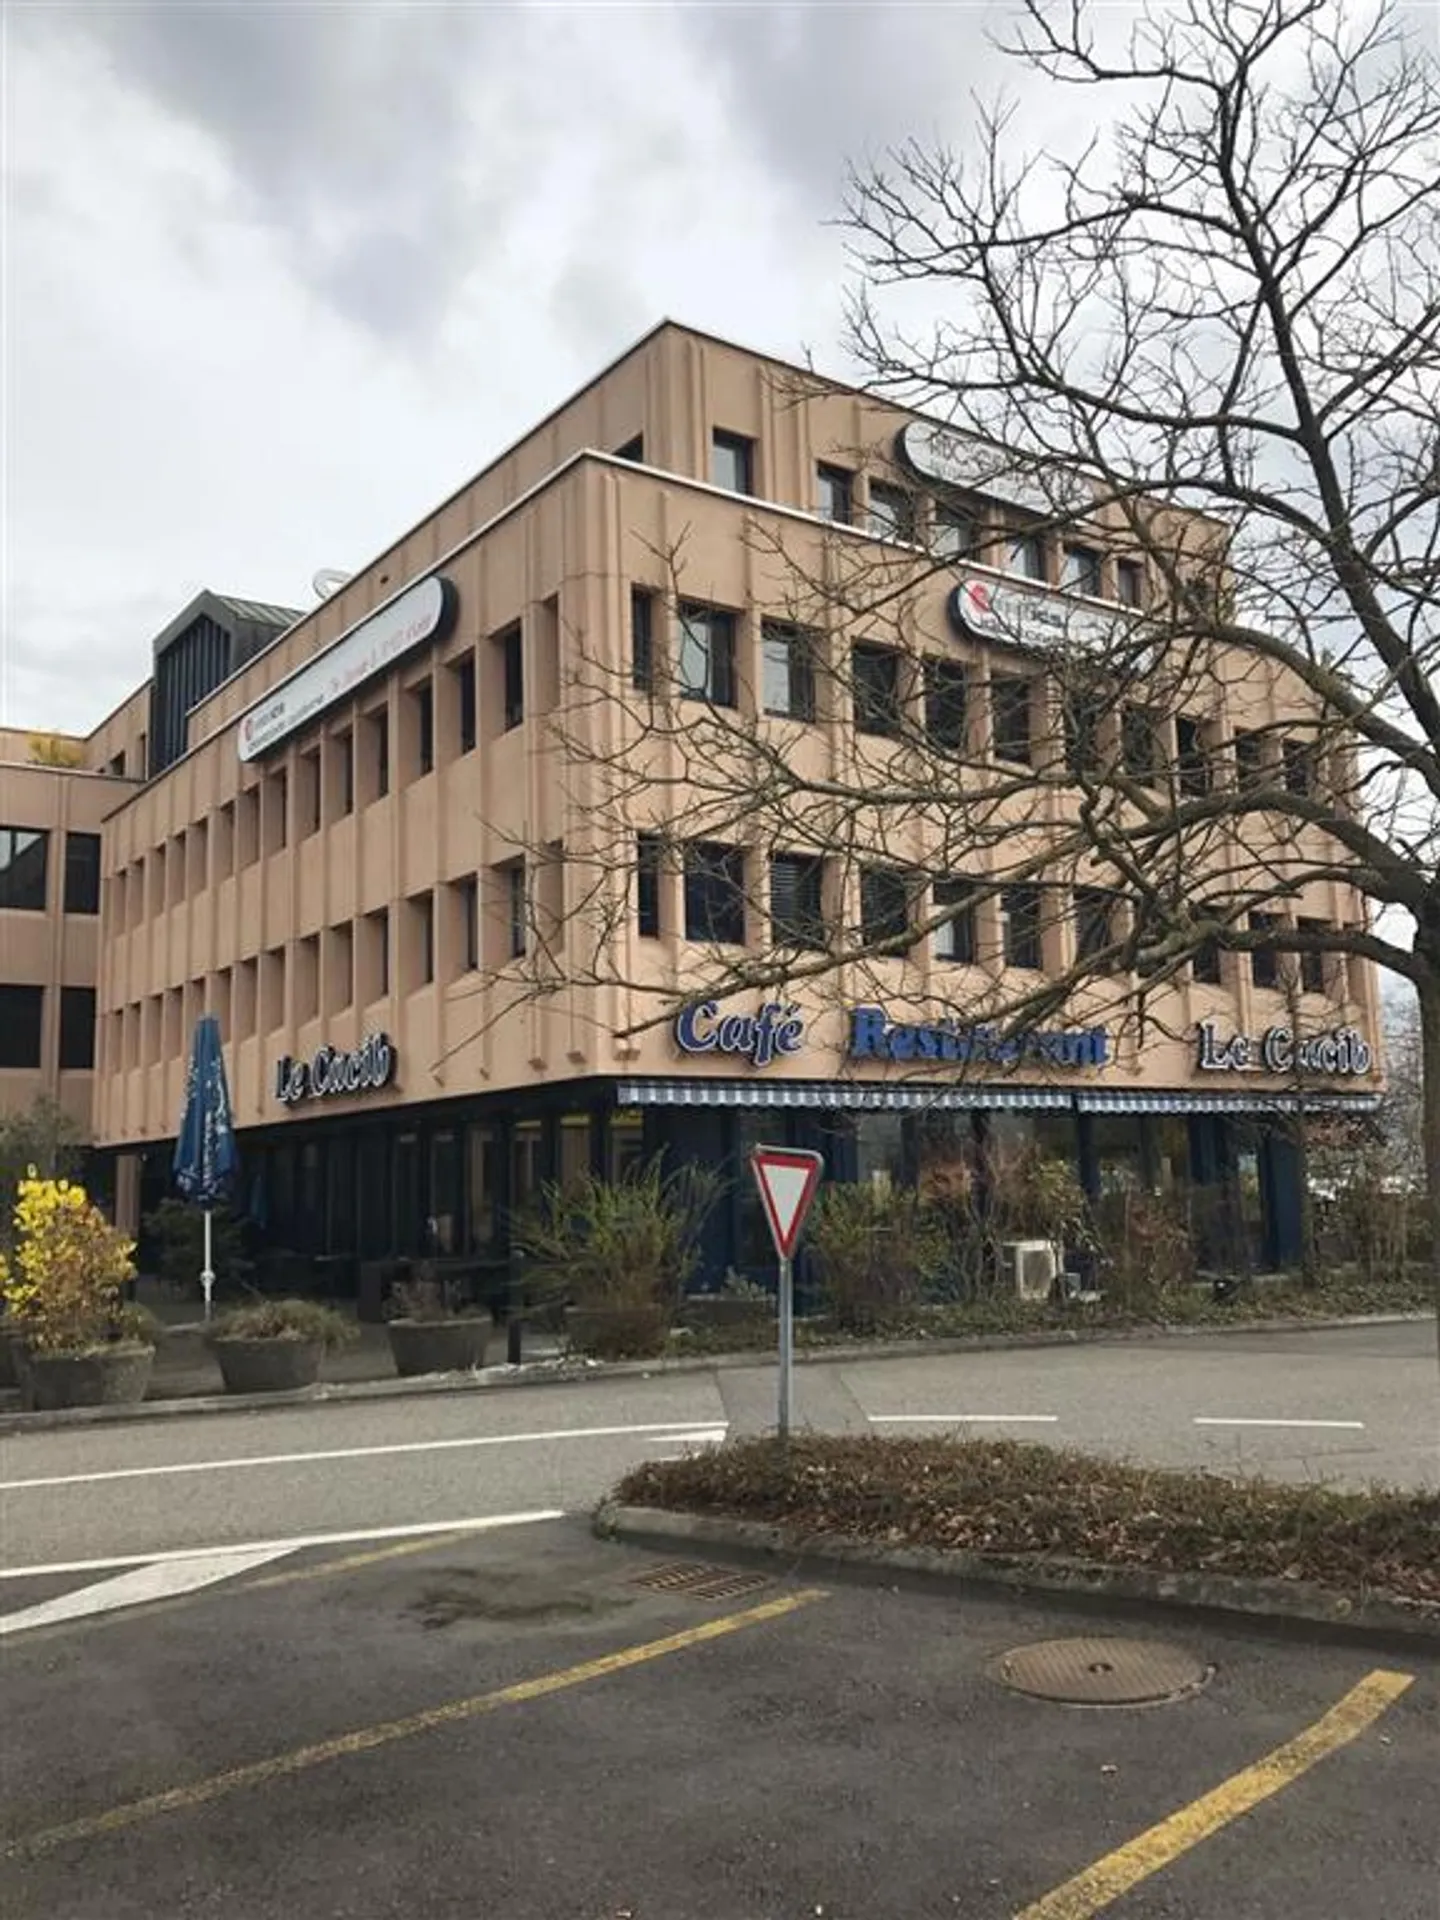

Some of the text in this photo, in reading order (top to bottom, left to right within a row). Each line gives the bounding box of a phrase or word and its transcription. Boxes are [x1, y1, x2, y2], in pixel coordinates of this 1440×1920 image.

[676, 1000, 804, 1067] Café
[1198, 1018, 1252, 1072] Le
[277, 1055, 304, 1102] Le
